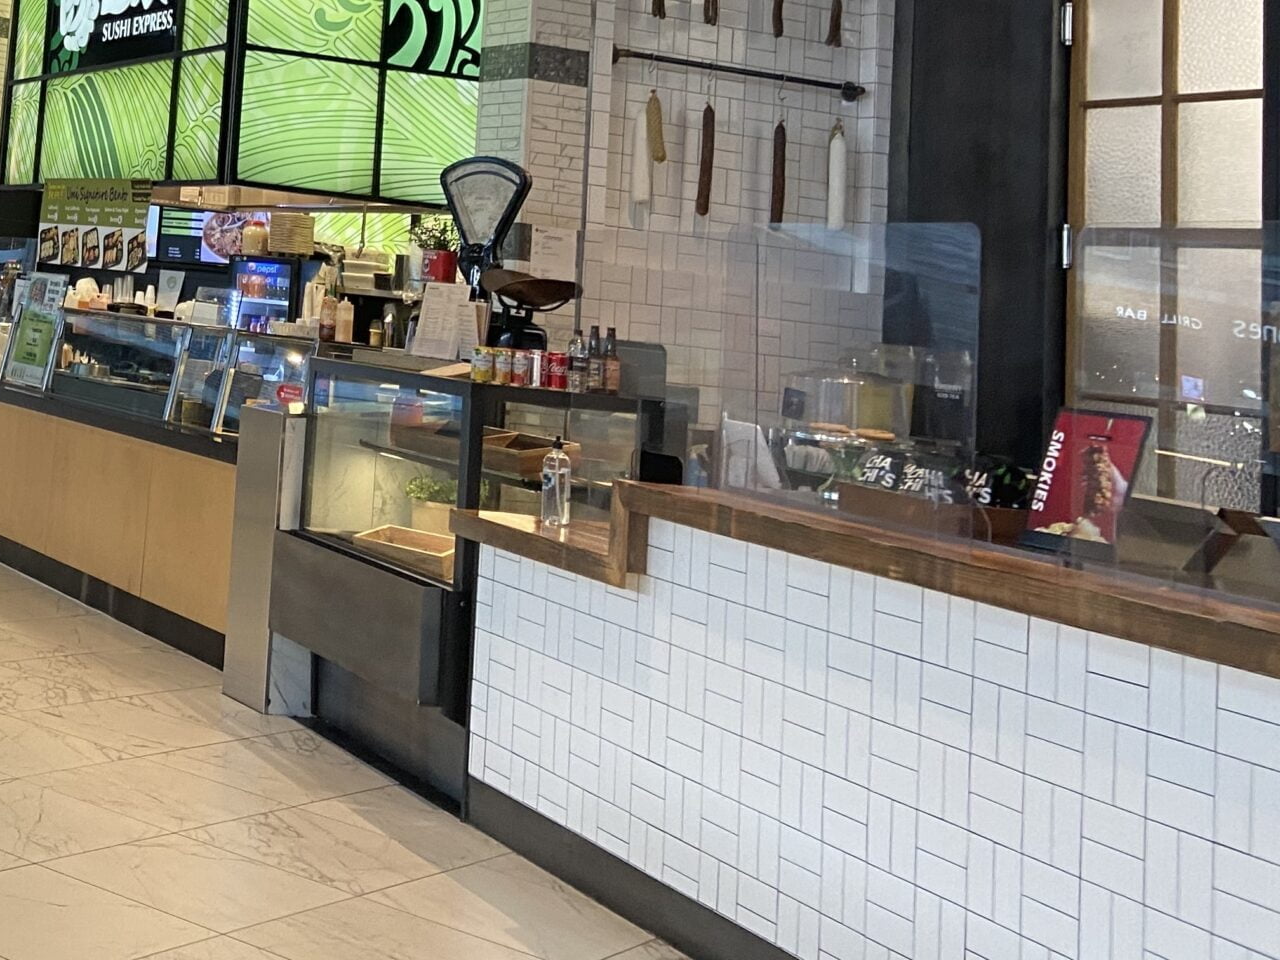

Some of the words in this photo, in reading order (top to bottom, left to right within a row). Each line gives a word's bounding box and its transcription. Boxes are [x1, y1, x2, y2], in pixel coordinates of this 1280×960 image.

[102, 17, 131, 43] SUSHI
[132, 9, 174, 36] EXPRESS
[256, 264, 278, 274] pepsi
[1031, 430, 1065, 512] SMOKIES
